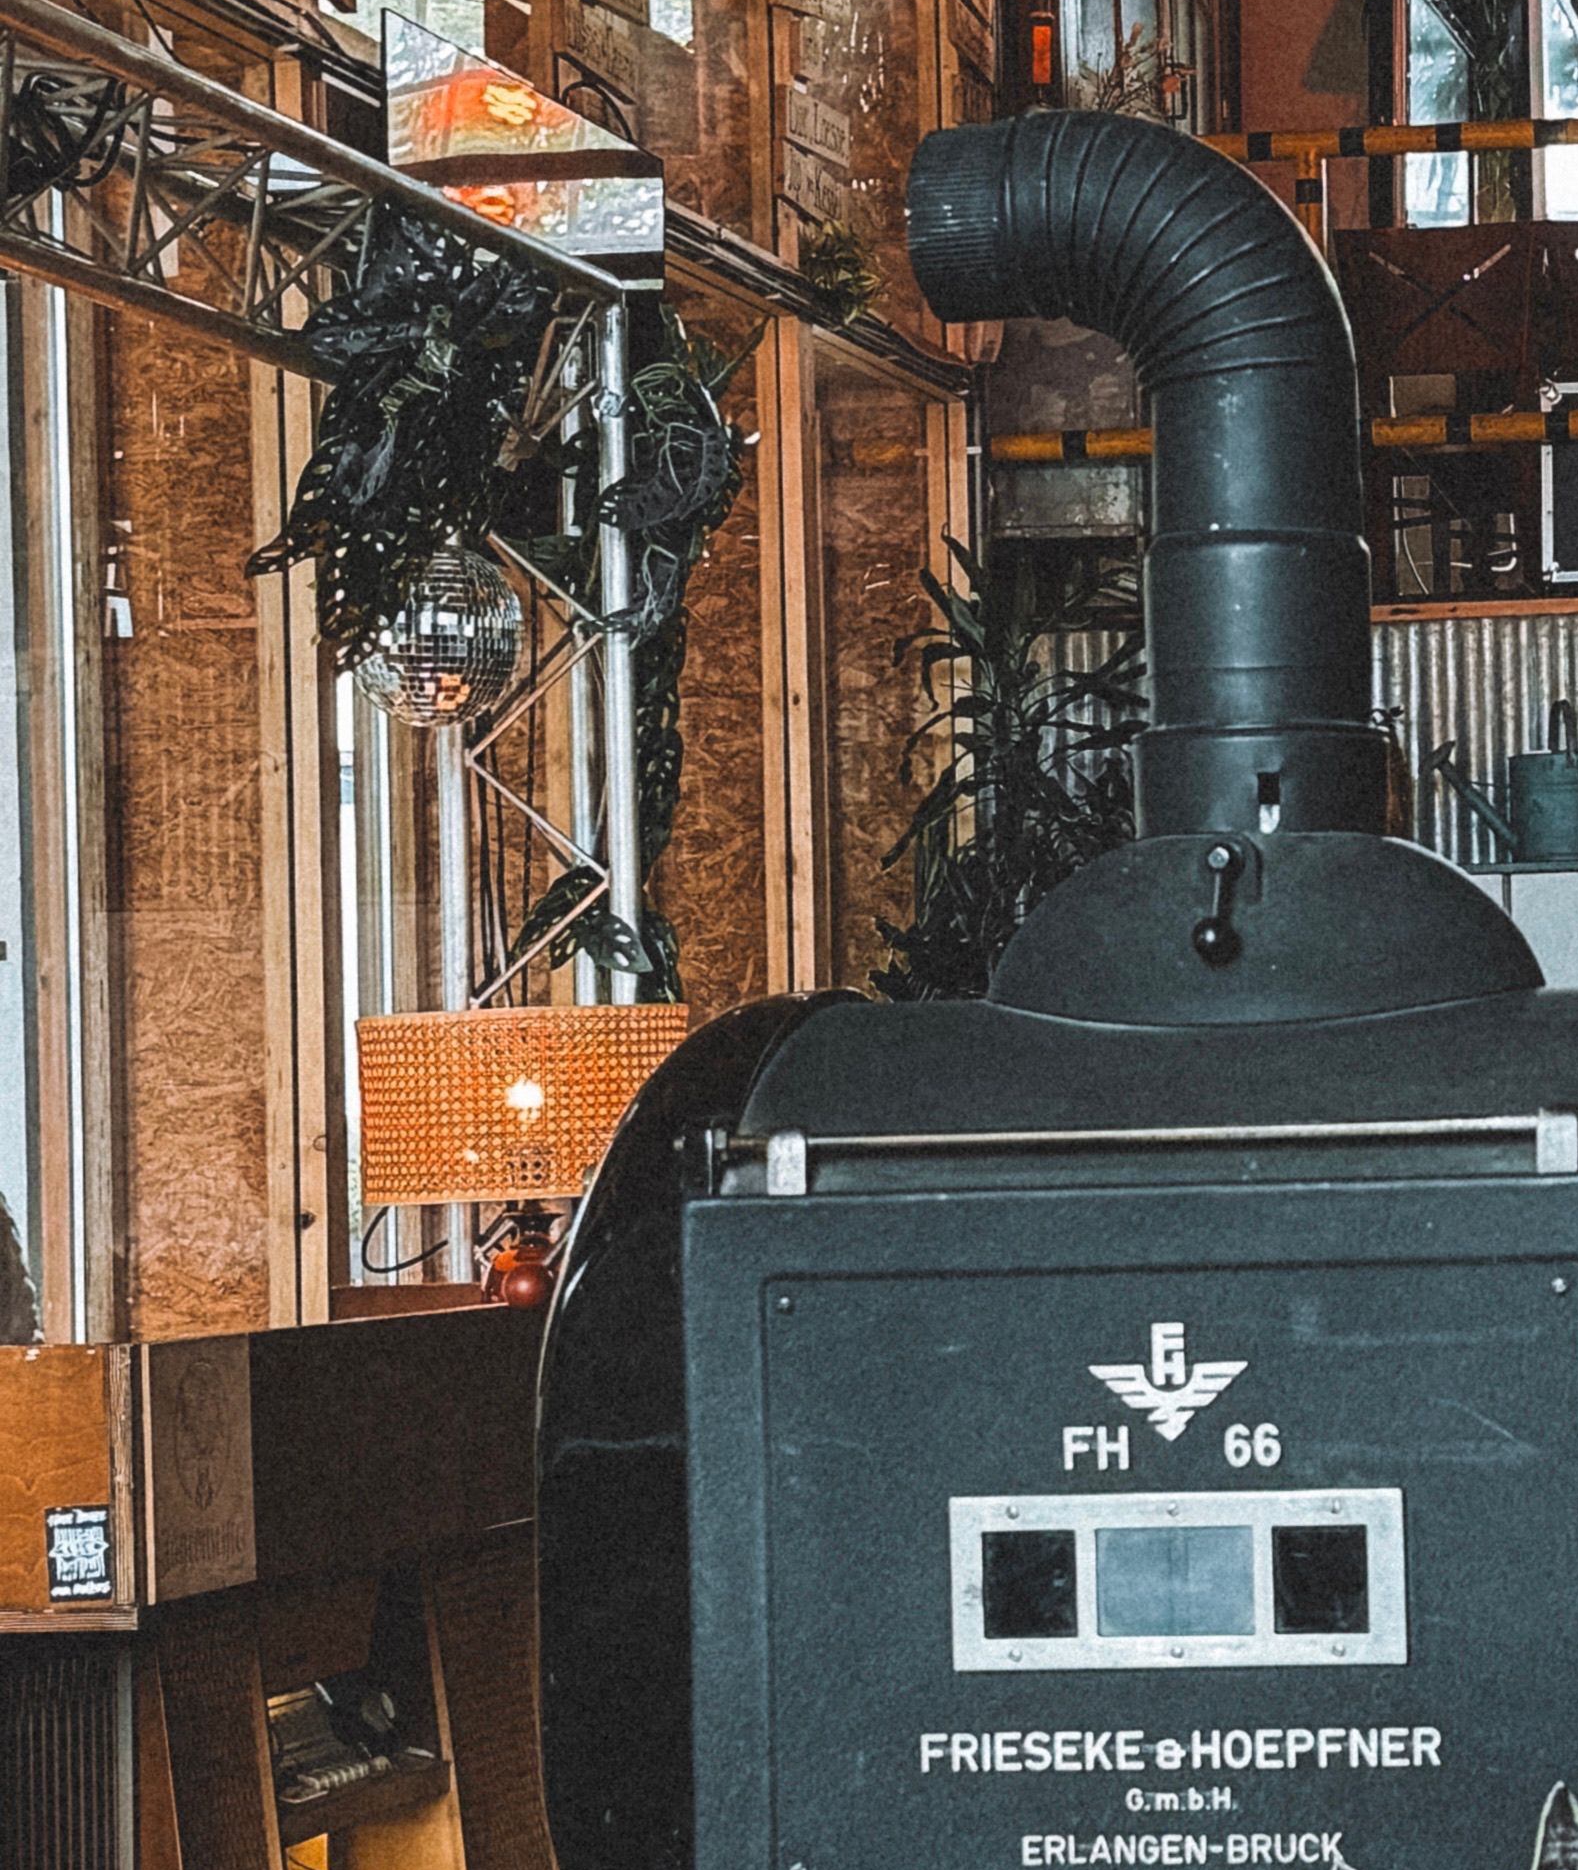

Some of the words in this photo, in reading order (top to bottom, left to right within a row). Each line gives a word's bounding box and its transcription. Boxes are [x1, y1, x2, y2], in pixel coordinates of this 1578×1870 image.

[1062, 1424, 1131, 1472] FH
[1223, 1421, 1283, 1469] 66
[919, 1729, 1146, 1774] FRIESEKE
[1154, 1737, 1187, 1771] &
[1190, 1725, 1443, 1771] HOEPFNER
[1020, 1832, 1343, 1867] ERLANGEN-BRUCK
